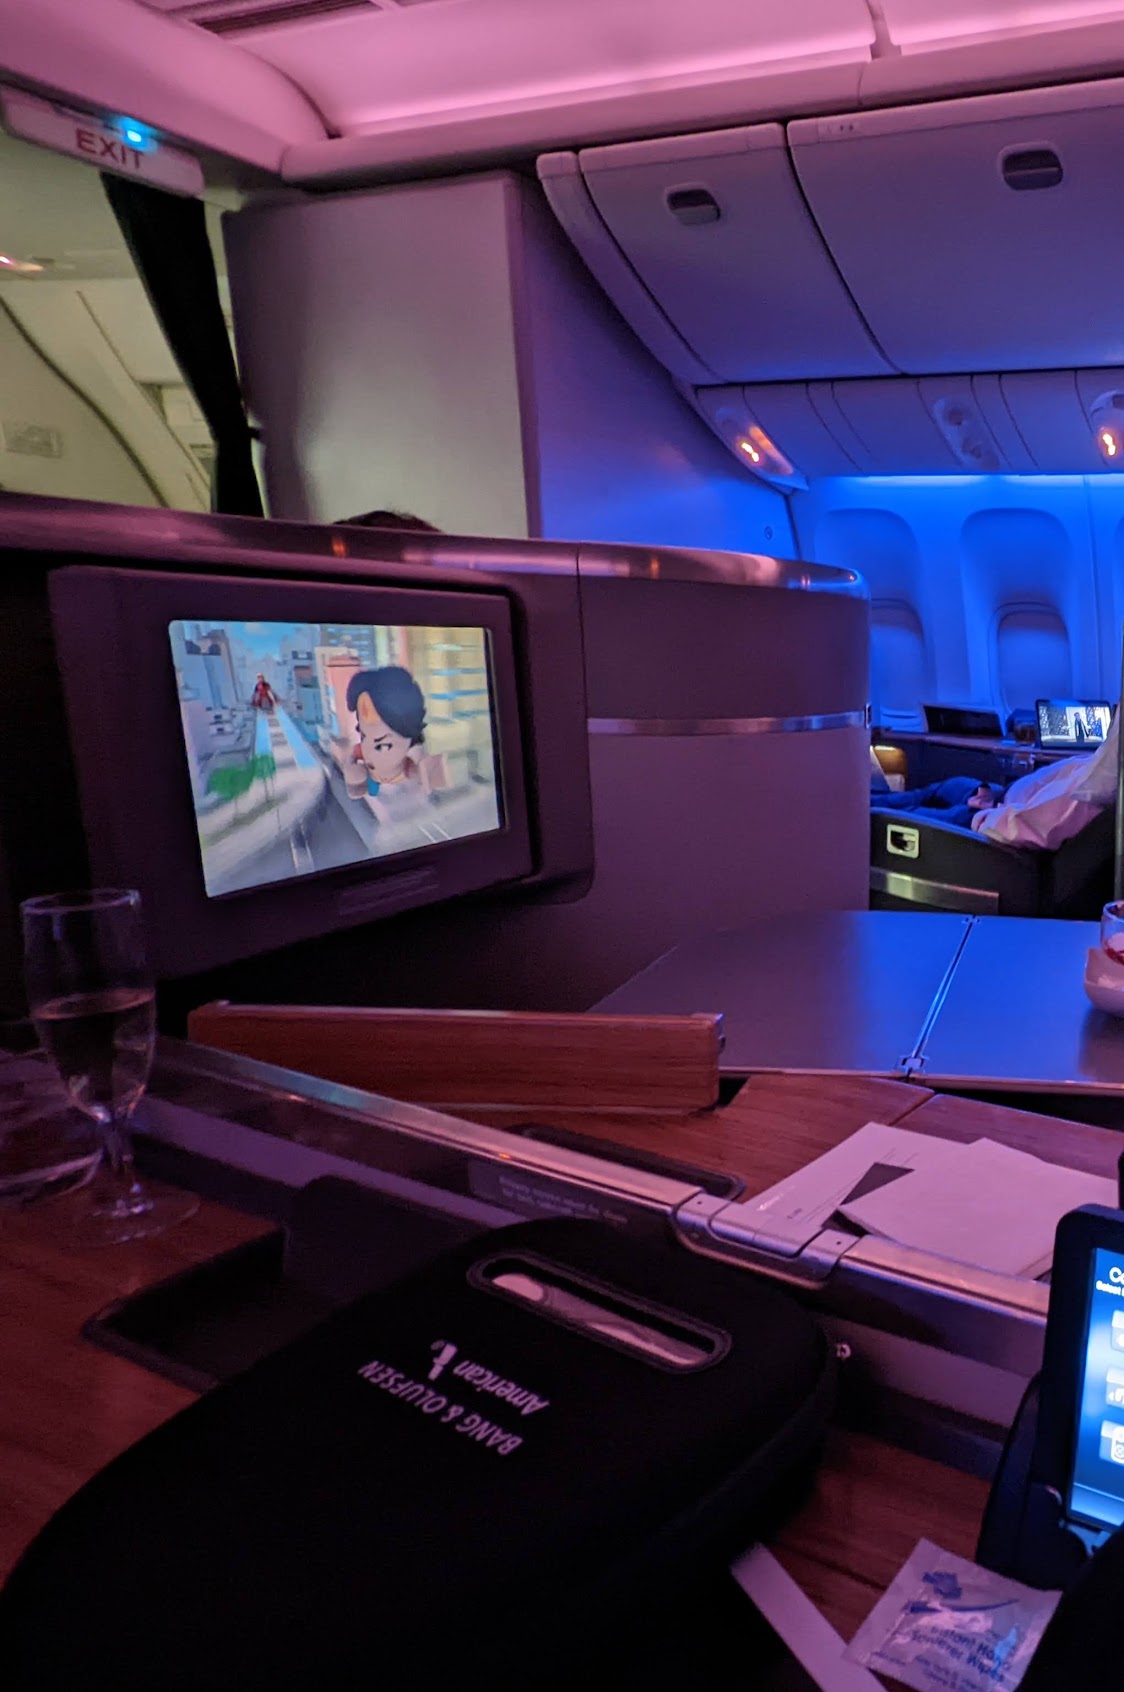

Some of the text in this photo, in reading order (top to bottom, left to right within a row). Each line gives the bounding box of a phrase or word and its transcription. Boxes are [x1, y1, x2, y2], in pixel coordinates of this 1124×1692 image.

[75, 128, 144, 169] EXIT
[357, 1360, 523, 1455] BANG & OLUFSEN
[453, 1360, 550, 1416] American
